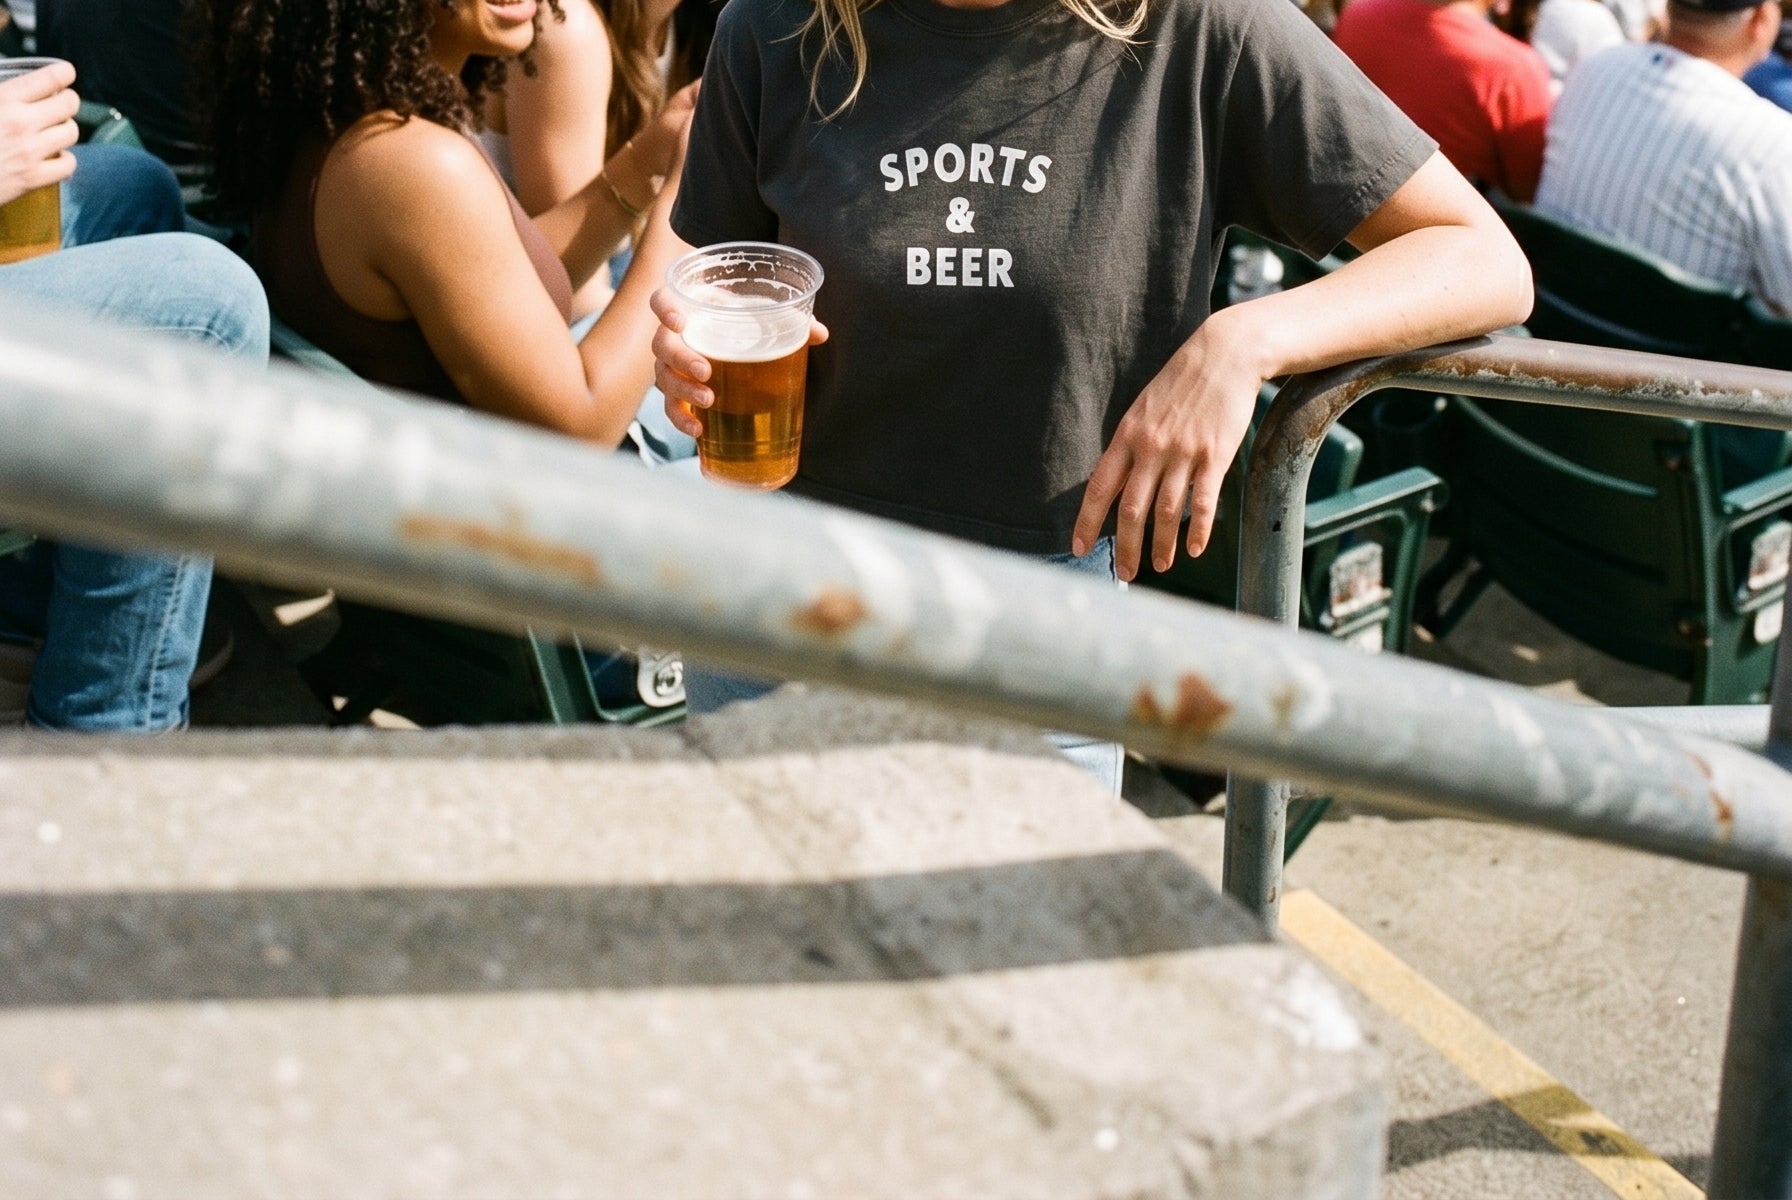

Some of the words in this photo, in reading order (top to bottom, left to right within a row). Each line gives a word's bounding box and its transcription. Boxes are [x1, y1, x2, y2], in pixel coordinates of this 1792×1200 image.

[879, 142, 1053, 194] SPORTS
[945, 196, 976, 234] &
[906, 246, 1015, 288] BEER
